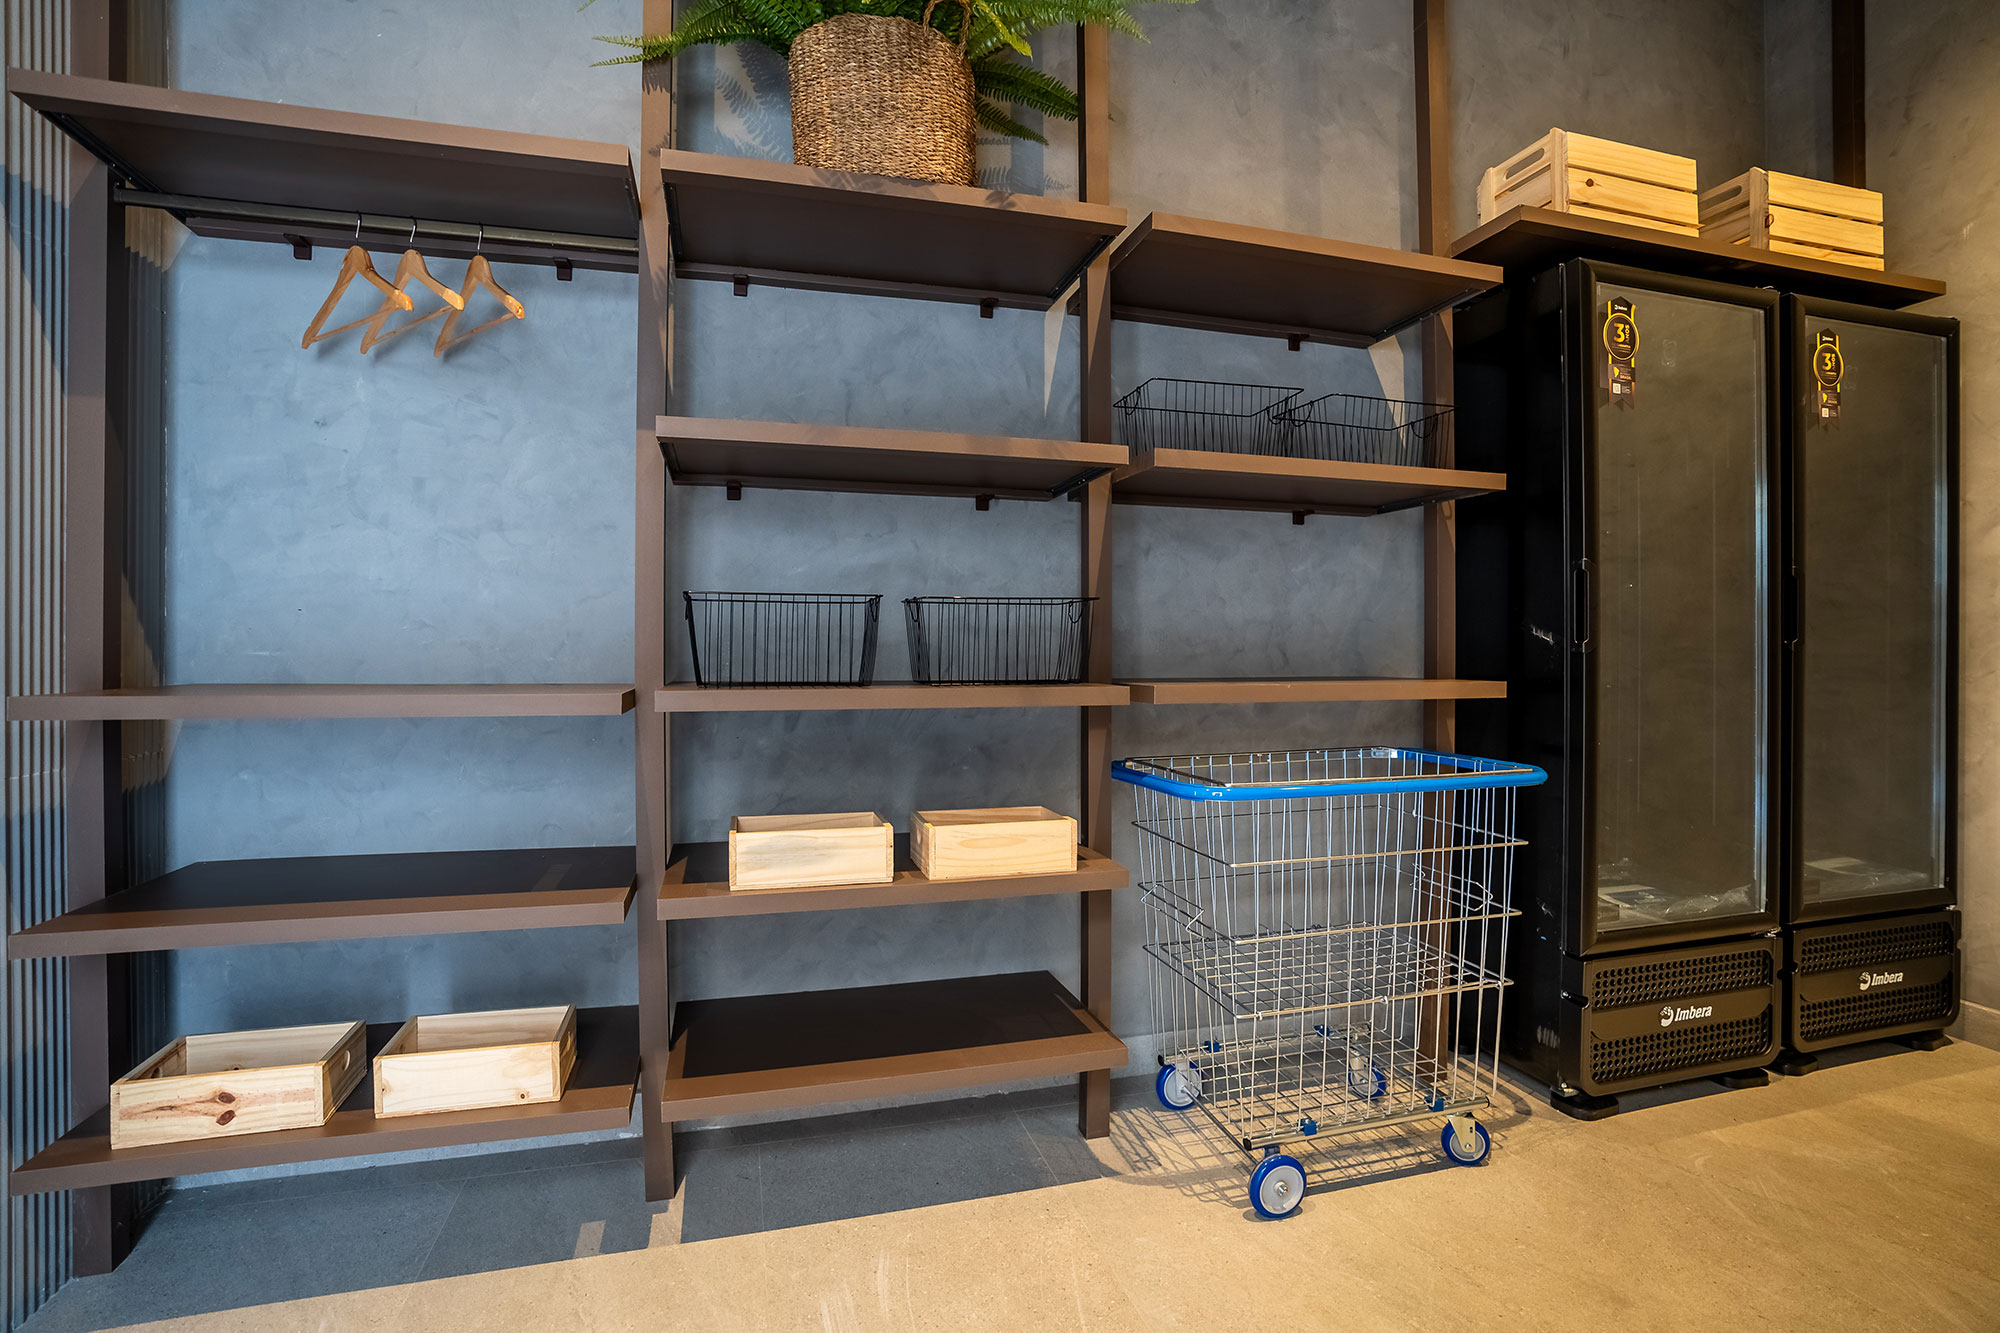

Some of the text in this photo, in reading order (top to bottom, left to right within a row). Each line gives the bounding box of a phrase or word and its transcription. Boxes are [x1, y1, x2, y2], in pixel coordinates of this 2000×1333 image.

[1613, 323, 1625, 343] 3
[1822, 352, 1832, 370] 3
[1871, 971, 1904, 986] Imbera
[1674, 1005, 1713, 1022] Imbera
